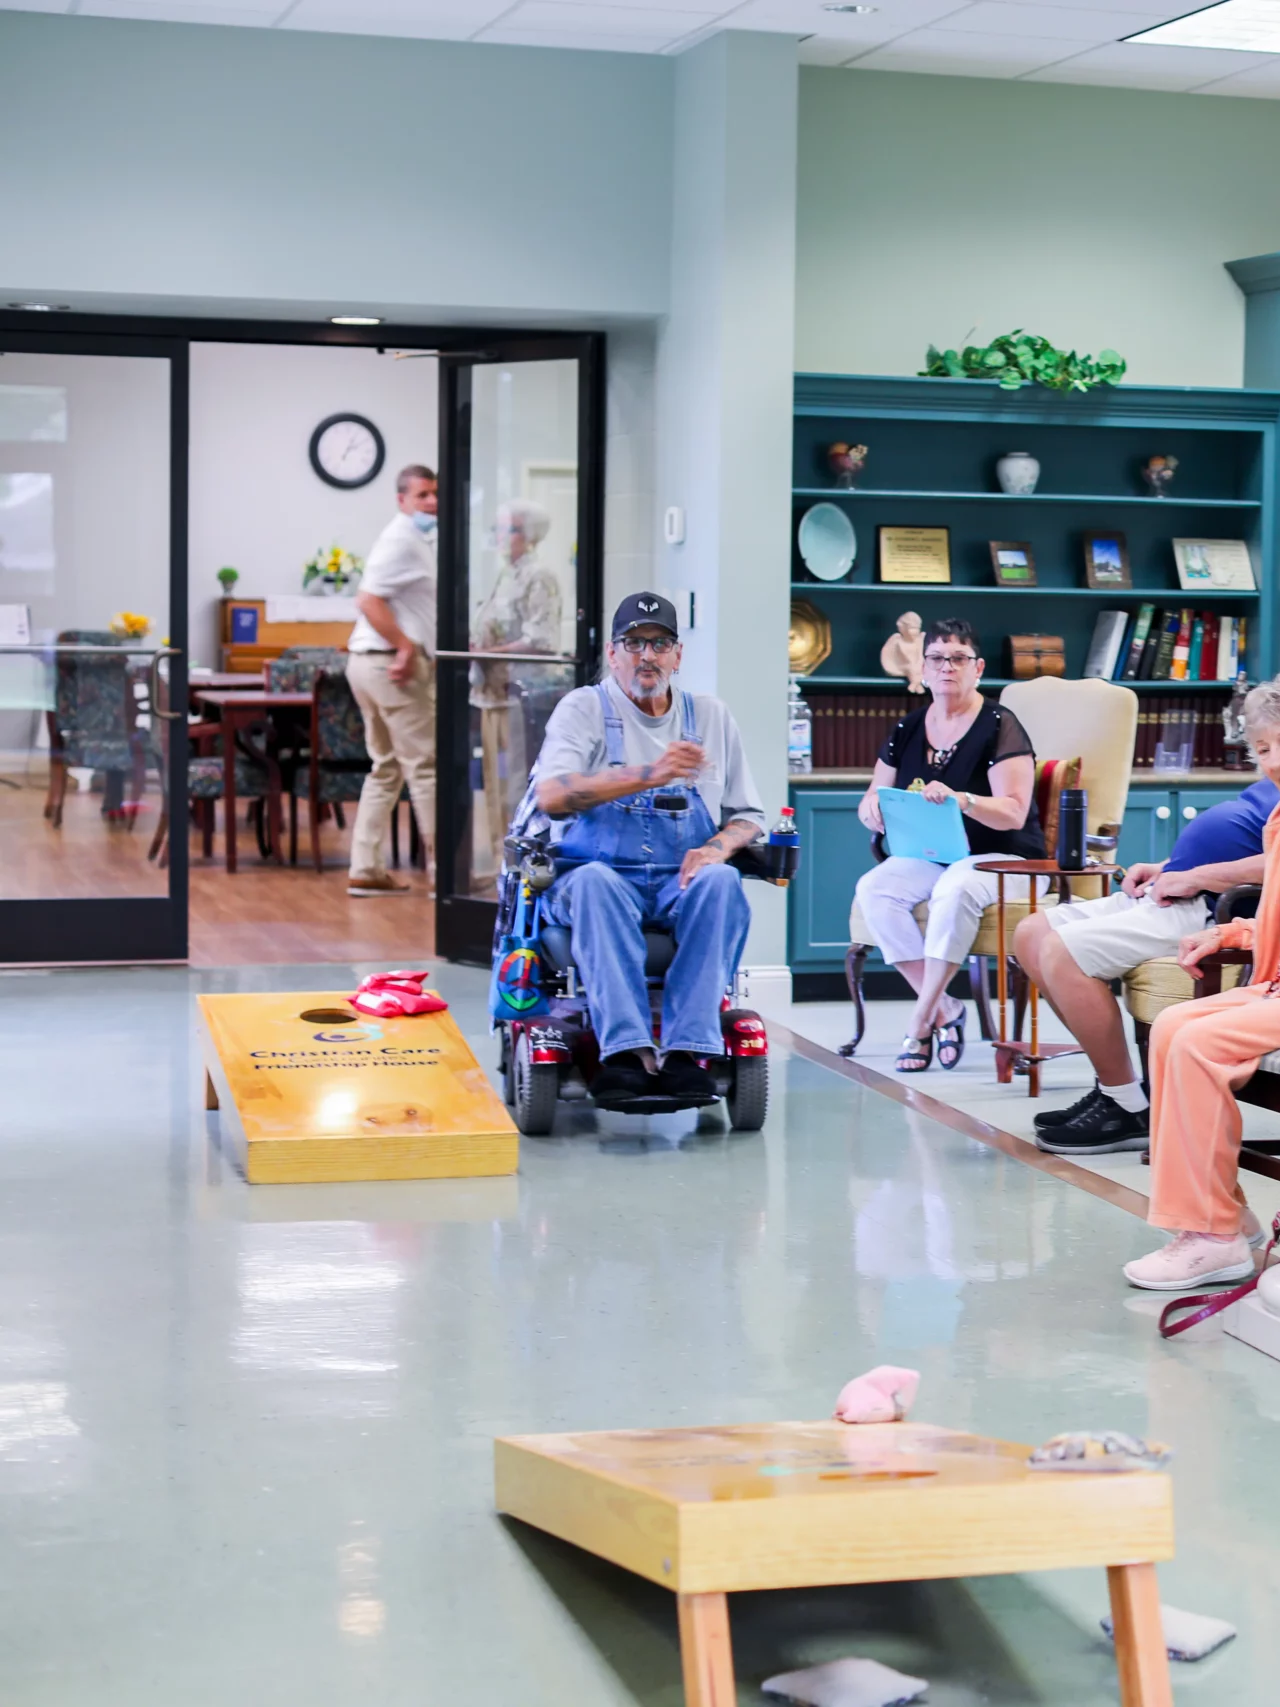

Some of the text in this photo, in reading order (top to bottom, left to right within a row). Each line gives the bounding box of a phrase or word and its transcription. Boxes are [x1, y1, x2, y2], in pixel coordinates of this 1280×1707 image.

[250, 1047, 440, 1058] Christian Care
[254, 1062, 367, 1070] Friendship
